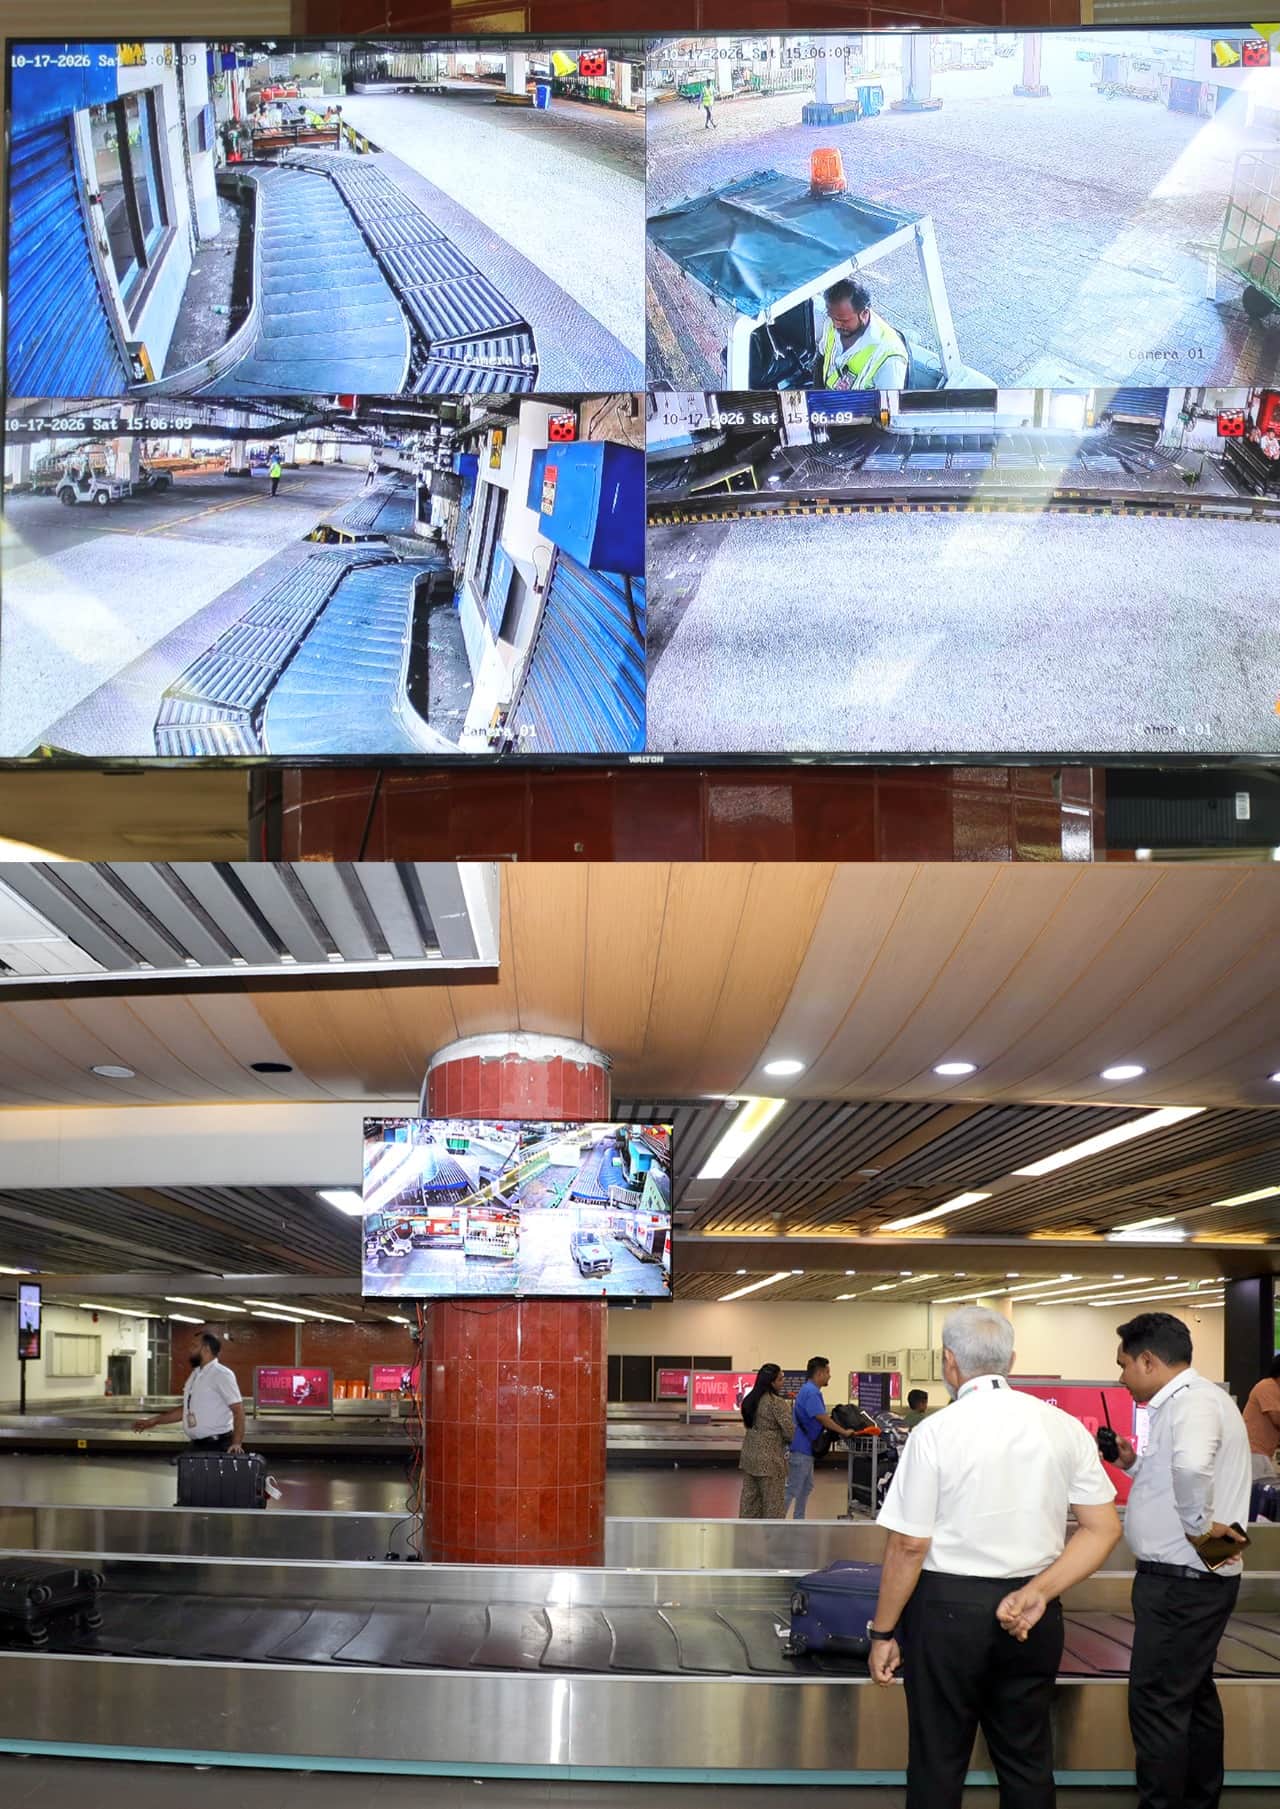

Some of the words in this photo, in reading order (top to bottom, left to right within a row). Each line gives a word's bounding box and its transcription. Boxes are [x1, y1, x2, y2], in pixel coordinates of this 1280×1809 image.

[663, 48, 744, 60] 10-17-2026
[786, 47, 851, 60] 15:06:09
[11, 55, 91, 68] 10-17-2026
[464, 354, 512, 365] Camera
[521, 353, 538, 366] 01
[1128, 348, 1179, 360] Camera
[1188, 348, 1204, 360] 01
[5, 418, 86, 431] 10-17-2026
[93, 418, 118, 430] Sat
[127, 417, 193, 430] 15:06:09
[663, 413, 745, 425] 10-17-2026
[752, 412, 778, 425] Sat
[787, 412, 853, 424] 15:06:09
[520, 724, 537, 737] 01
[1195, 723, 1211, 736] 01
[696, 1382, 728, 1394] POWER
